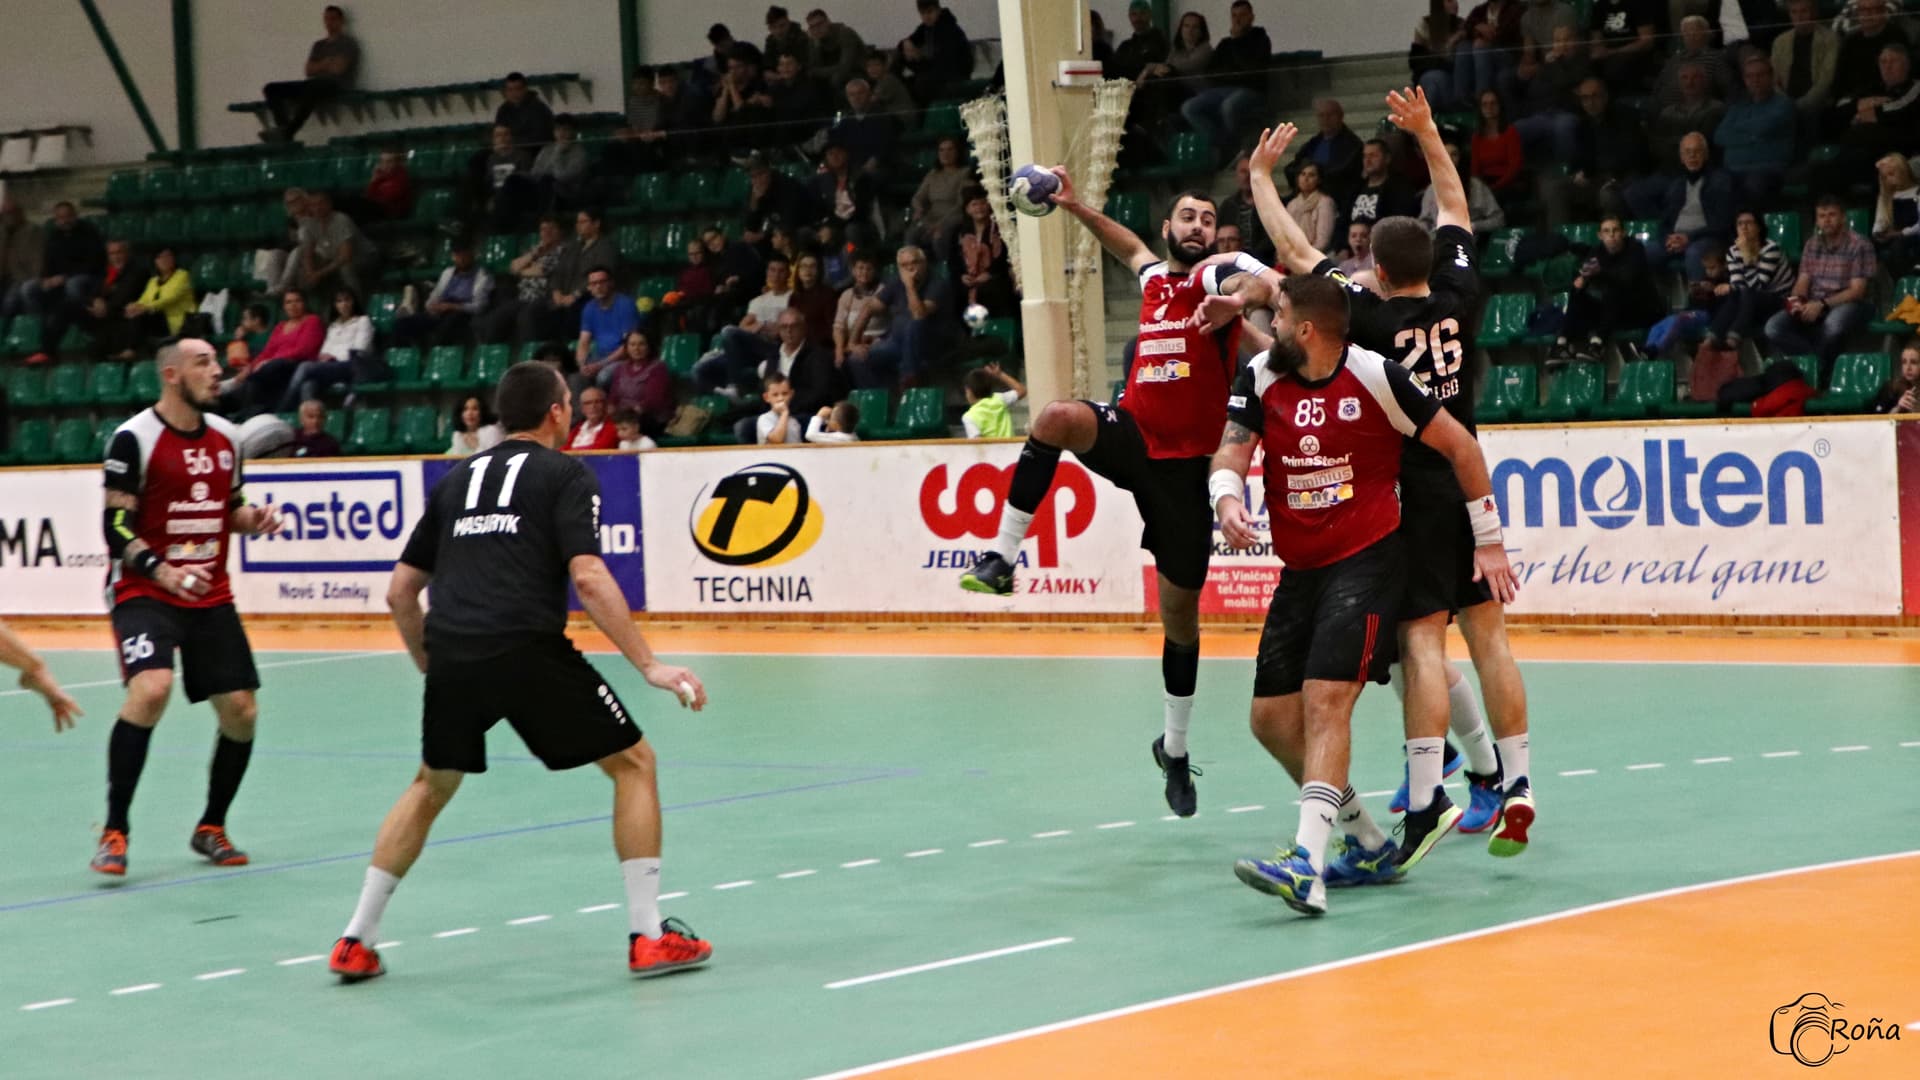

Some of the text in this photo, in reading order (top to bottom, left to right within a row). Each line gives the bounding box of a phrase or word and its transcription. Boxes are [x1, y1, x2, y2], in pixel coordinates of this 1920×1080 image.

[1394, 317, 1463, 383] 26
[1294, 397, 1326, 427] 85
[182, 447, 215, 475] 56
[1281, 453, 1352, 467] PrimaSteel
[464, 452, 530, 510] 11
[1492, 439, 1824, 530] molten
[453, 513, 521, 537] MASARYK
[1551, 544, 1616, 585] the
[1621, 544, 1708, 585] real
[1711, 559, 1831, 601] game
[693, 576, 813, 602] TECHNIA
[122, 632, 155, 664] 56
